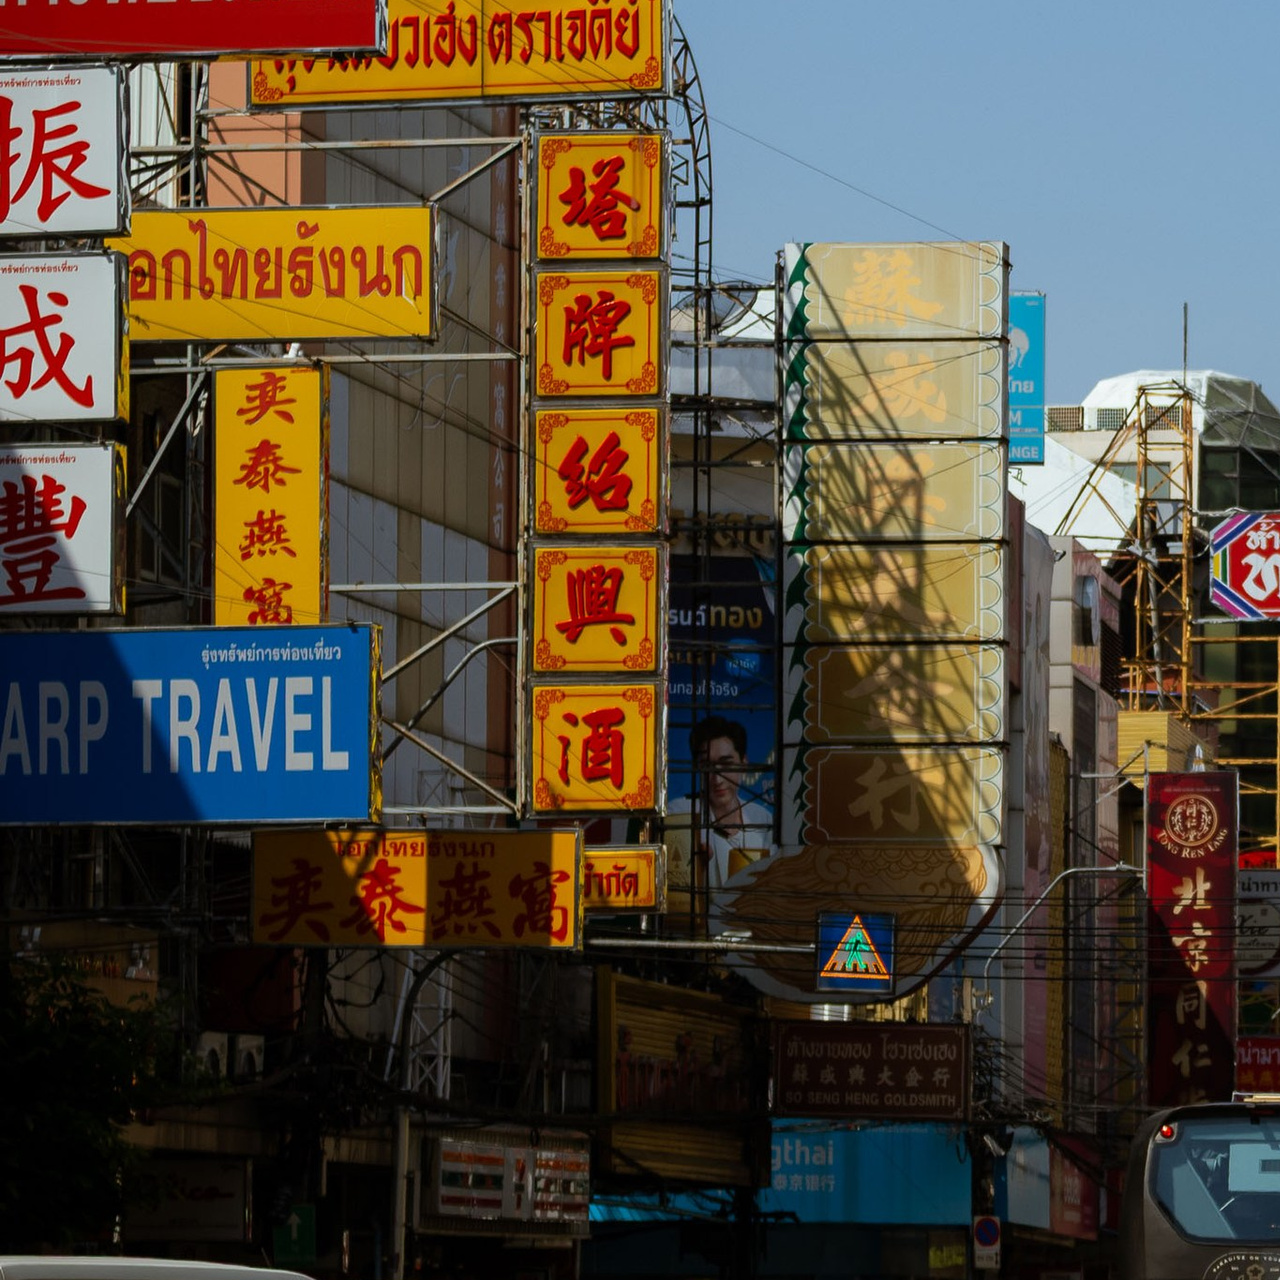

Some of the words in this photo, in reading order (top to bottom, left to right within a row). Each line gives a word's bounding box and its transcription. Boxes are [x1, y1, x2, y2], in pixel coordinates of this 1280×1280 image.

[555, 155, 642, 789] 塔牌紹興酒
[0, 680, 109, 775] ARP
[133, 676, 350, 775] TRAVEL
[1181, 845, 1206, 859] REN
[786, 1090, 804, 1105] SO
[845, 1092, 881, 1107] HENG
[883, 1093, 957, 1109] GOLDSMITH
[769, 1138, 835, 1173] gthai
